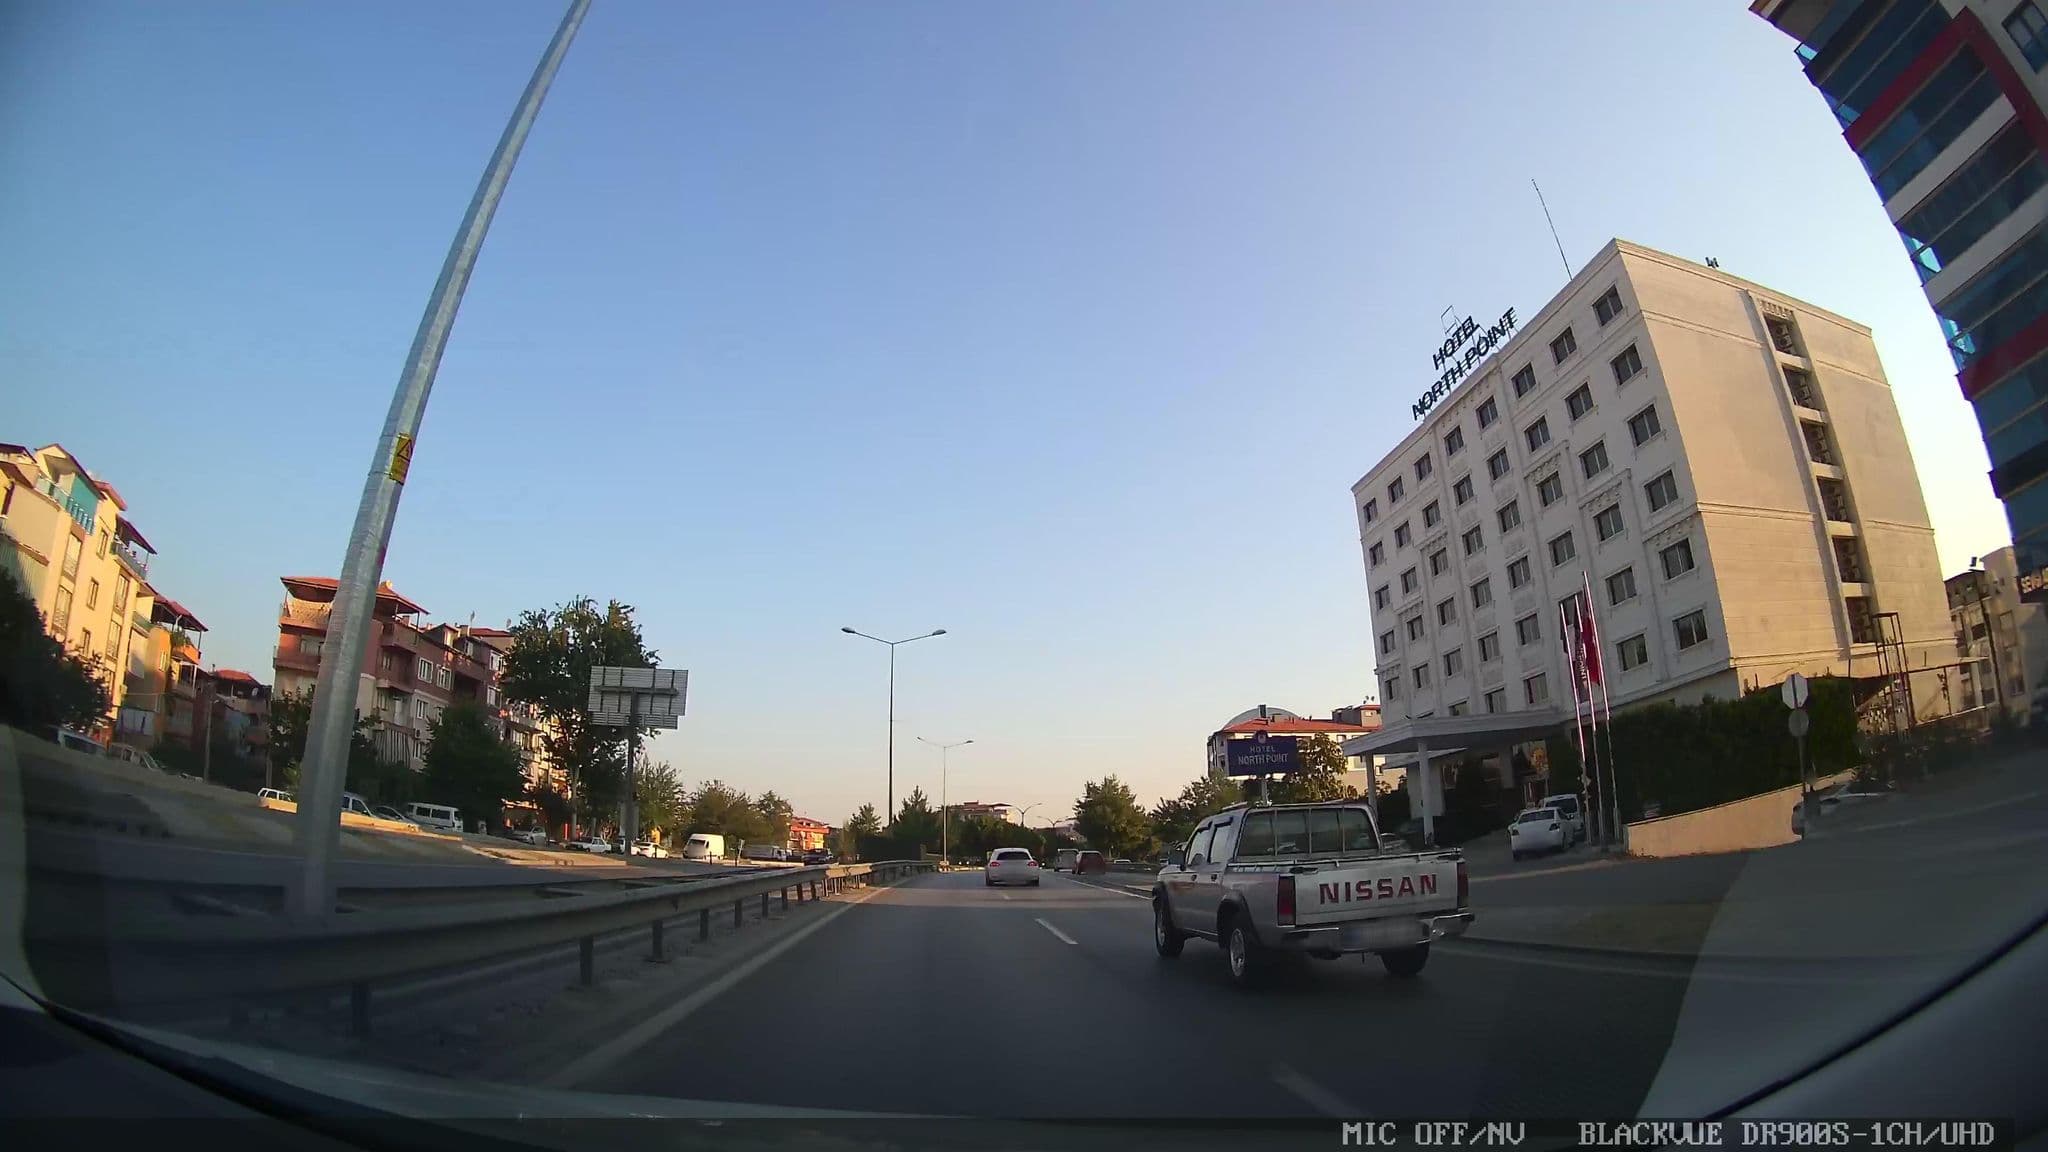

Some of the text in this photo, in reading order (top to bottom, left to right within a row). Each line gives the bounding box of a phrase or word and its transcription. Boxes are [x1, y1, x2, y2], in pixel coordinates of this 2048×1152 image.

[1412, 307, 1517, 420] NORTH POINT
[1432, 316, 1480, 370] HOTEL
[1238, 753, 1289, 765] NORTH POINT
[1318, 873, 1438, 905] NISSAN
